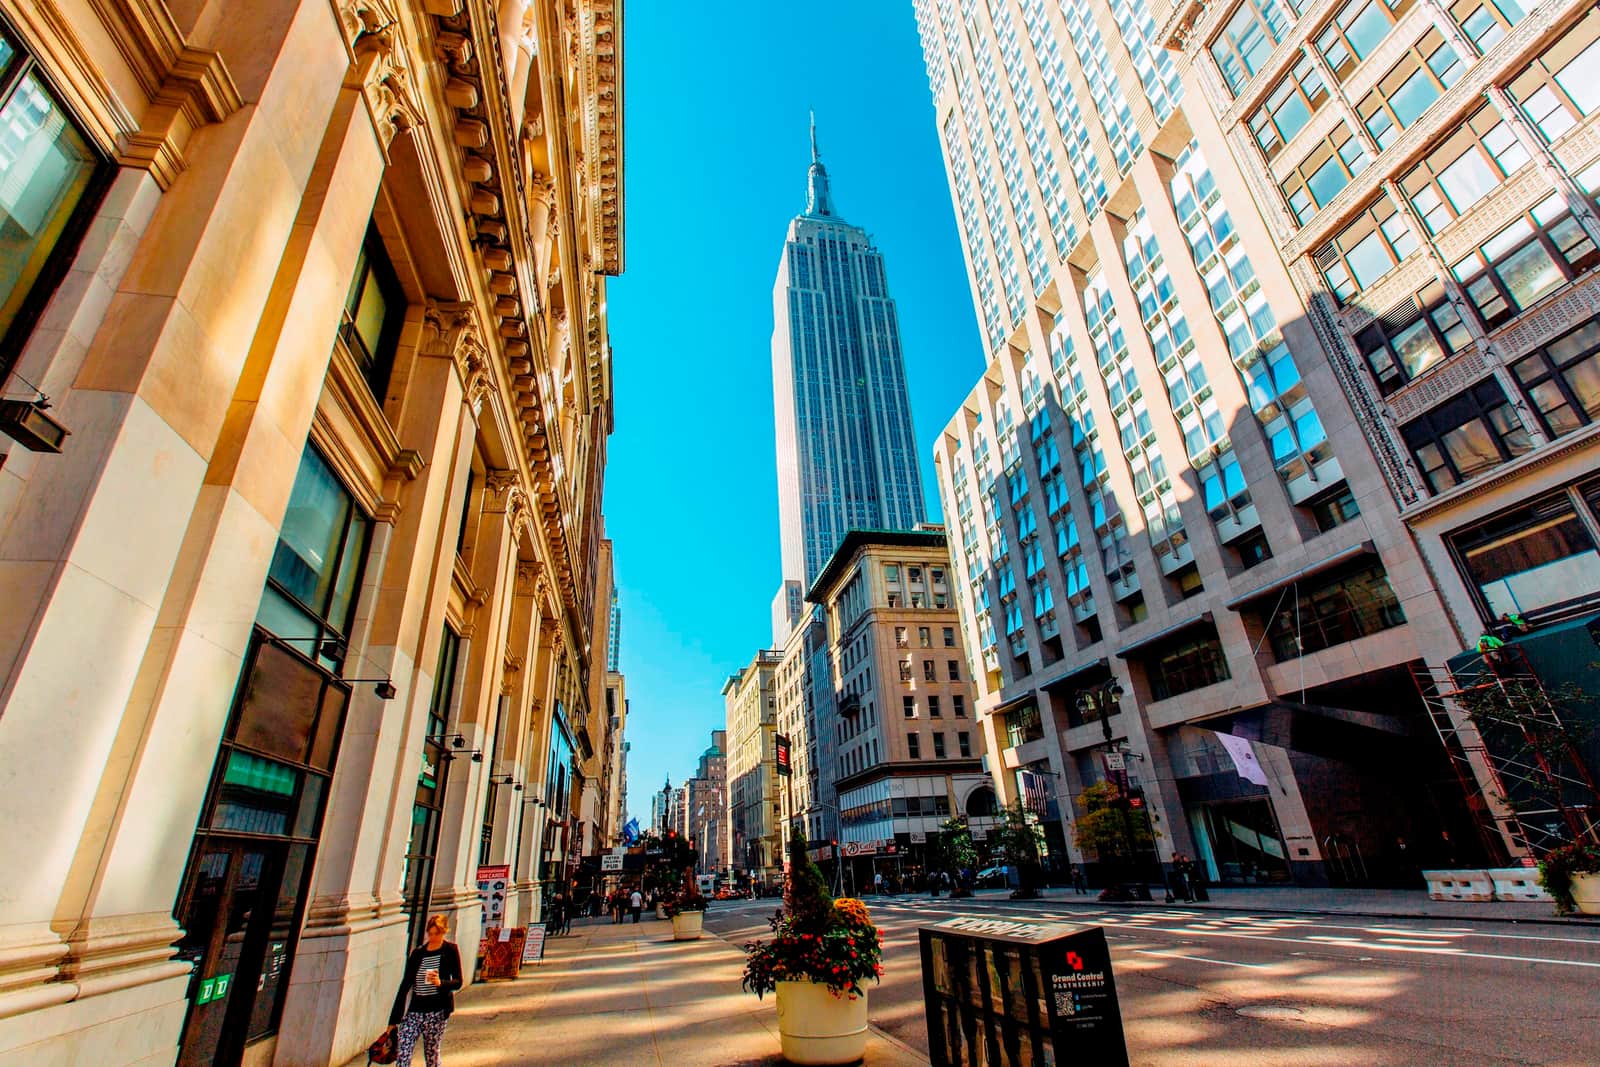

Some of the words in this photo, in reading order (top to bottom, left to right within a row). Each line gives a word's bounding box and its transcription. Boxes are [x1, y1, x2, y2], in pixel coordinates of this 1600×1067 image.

[1052, 973, 1076, 983] Grand
[1077, 971, 1104, 981] Central
[1053, 981, 1105, 989] PARTNERSHIP
